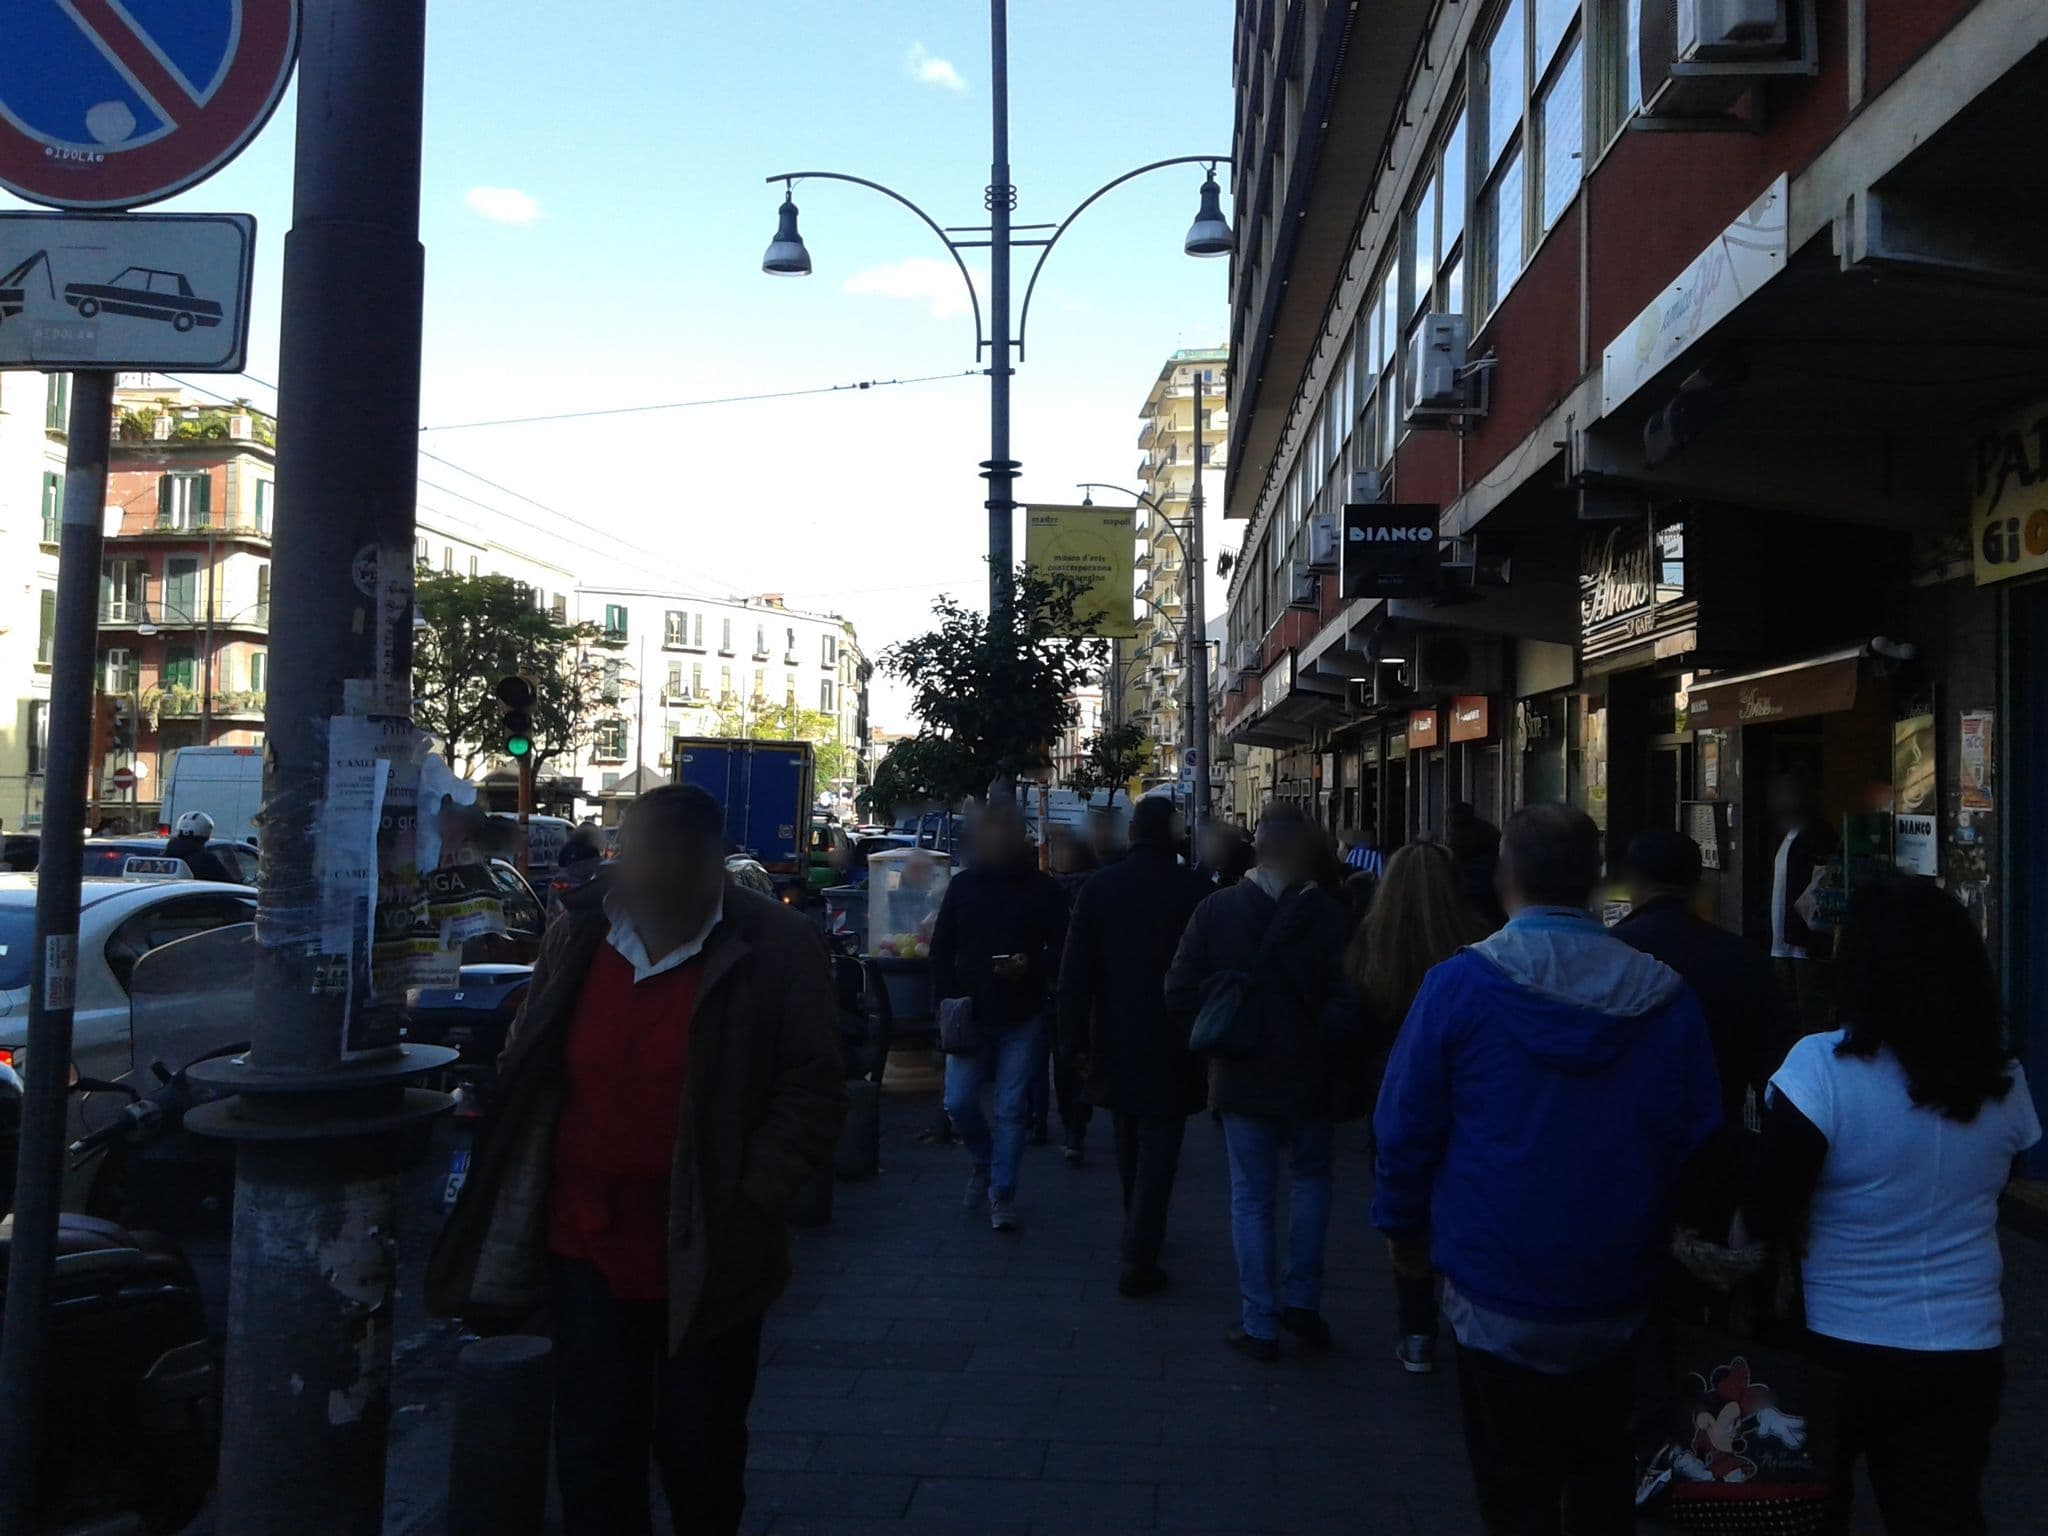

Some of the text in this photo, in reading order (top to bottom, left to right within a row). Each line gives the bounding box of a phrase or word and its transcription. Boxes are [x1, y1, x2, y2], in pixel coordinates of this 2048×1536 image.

[1103, 518, 1131, 527] napoli
[1047, 563, 1112, 572] contemporanea
[130, 860, 175, 873] TAXI
